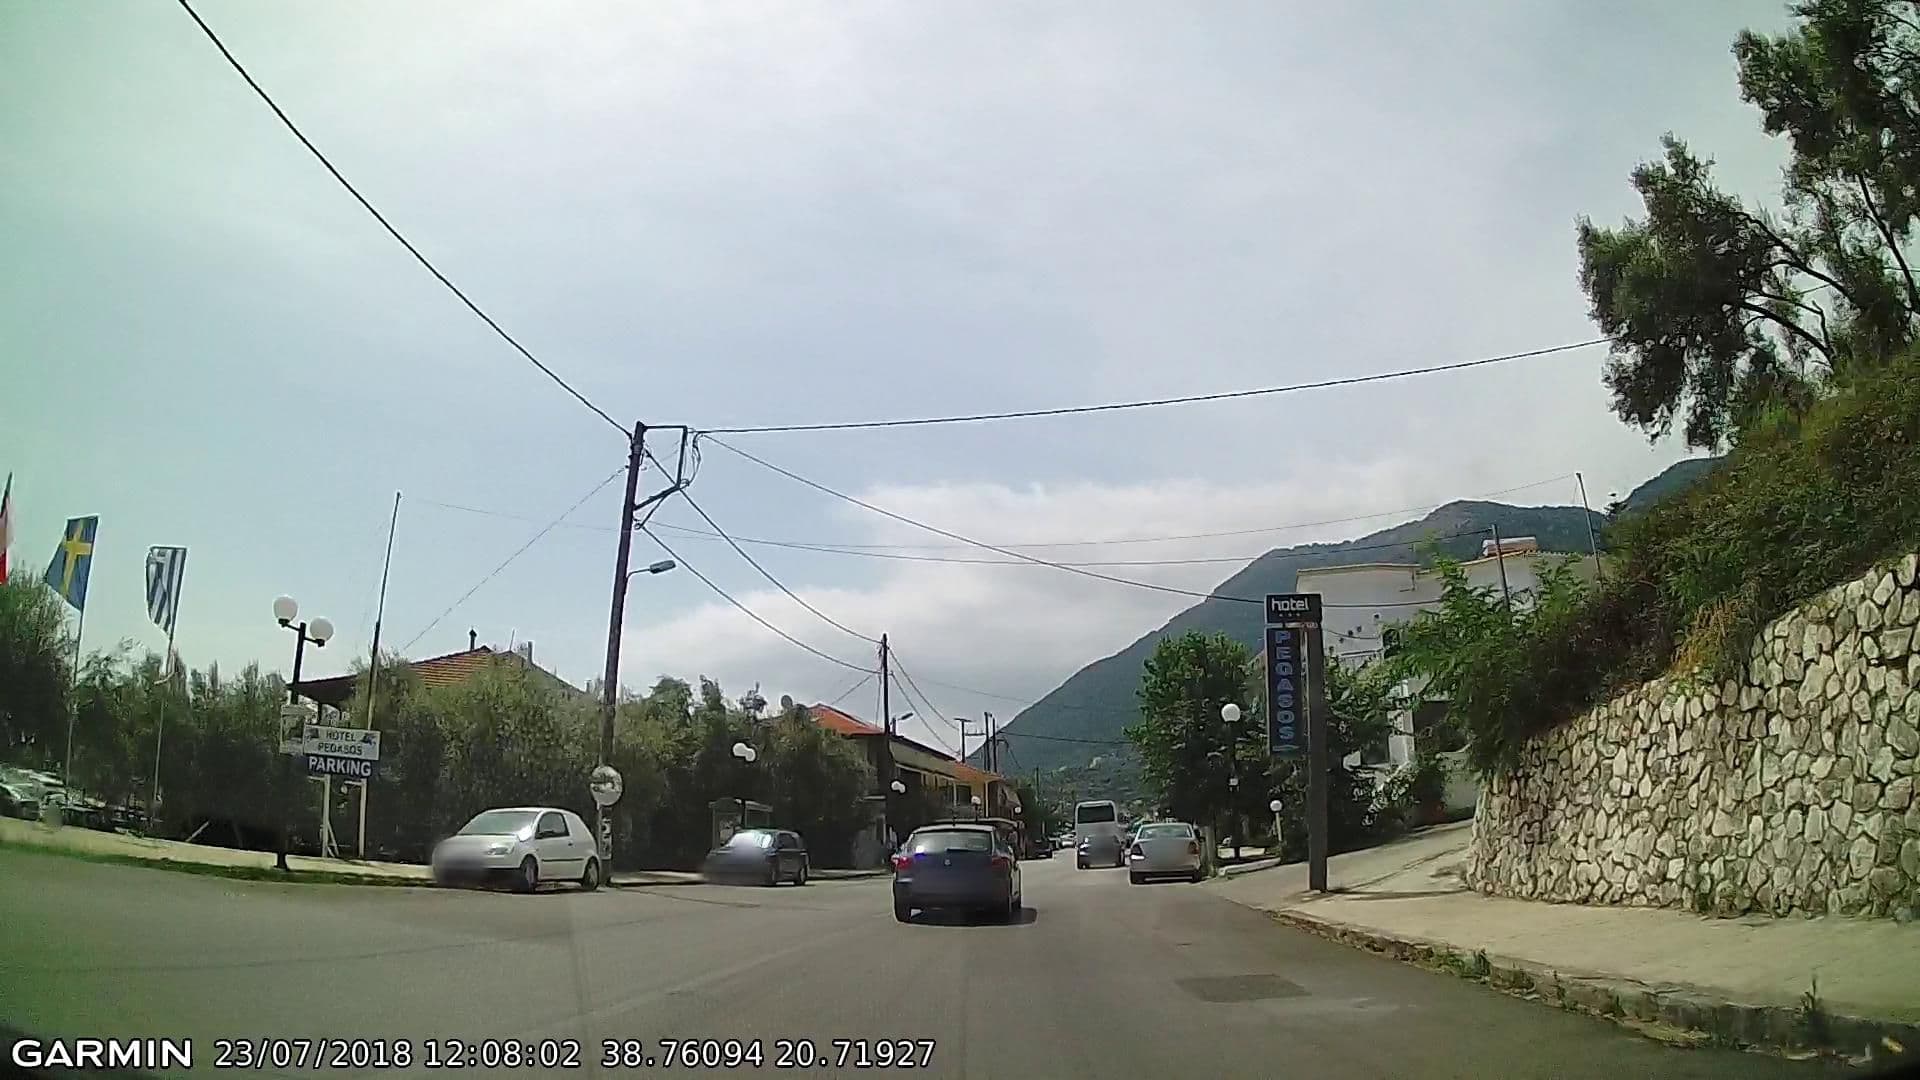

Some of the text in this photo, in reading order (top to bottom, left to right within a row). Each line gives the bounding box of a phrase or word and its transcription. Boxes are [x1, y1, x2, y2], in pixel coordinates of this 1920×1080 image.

[1271, 597, 1309, 611] hotel
[1275, 630, 1295, 739] PEGASOS
[326, 730, 356, 742] HOTEL
[318, 742, 362, 756] PEGASOS
[308, 756, 371, 777] PARKING
